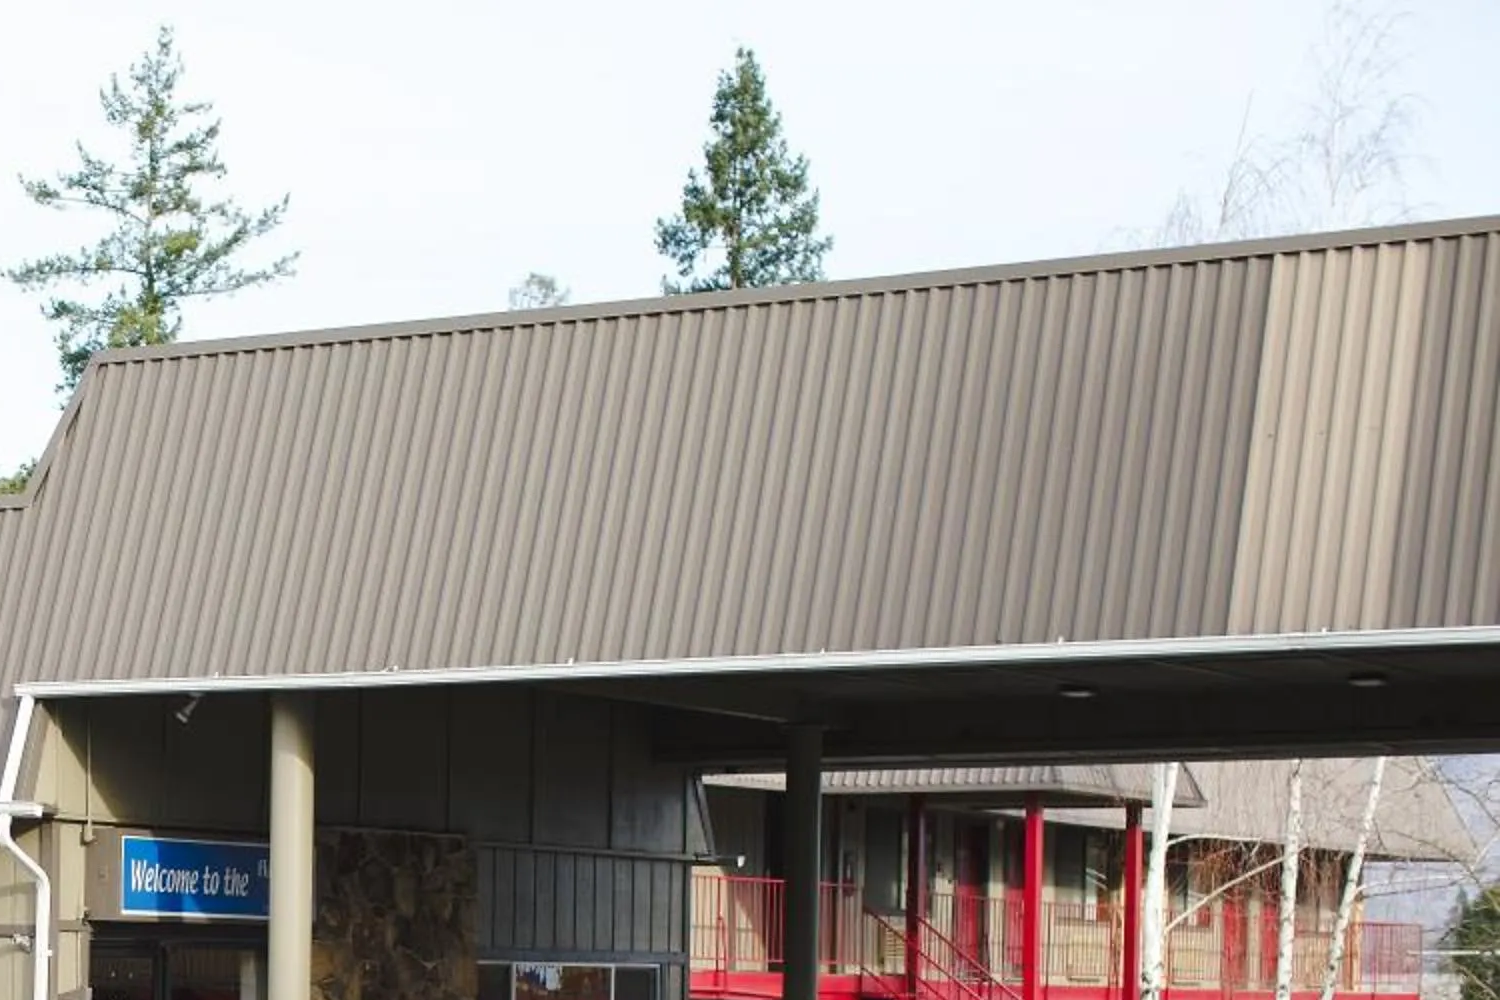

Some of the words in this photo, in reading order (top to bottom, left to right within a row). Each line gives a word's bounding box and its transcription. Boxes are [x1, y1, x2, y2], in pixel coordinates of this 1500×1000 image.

[131, 858, 199, 895] Welcome
[203, 865, 220, 896] to
[224, 866, 249, 897] the
